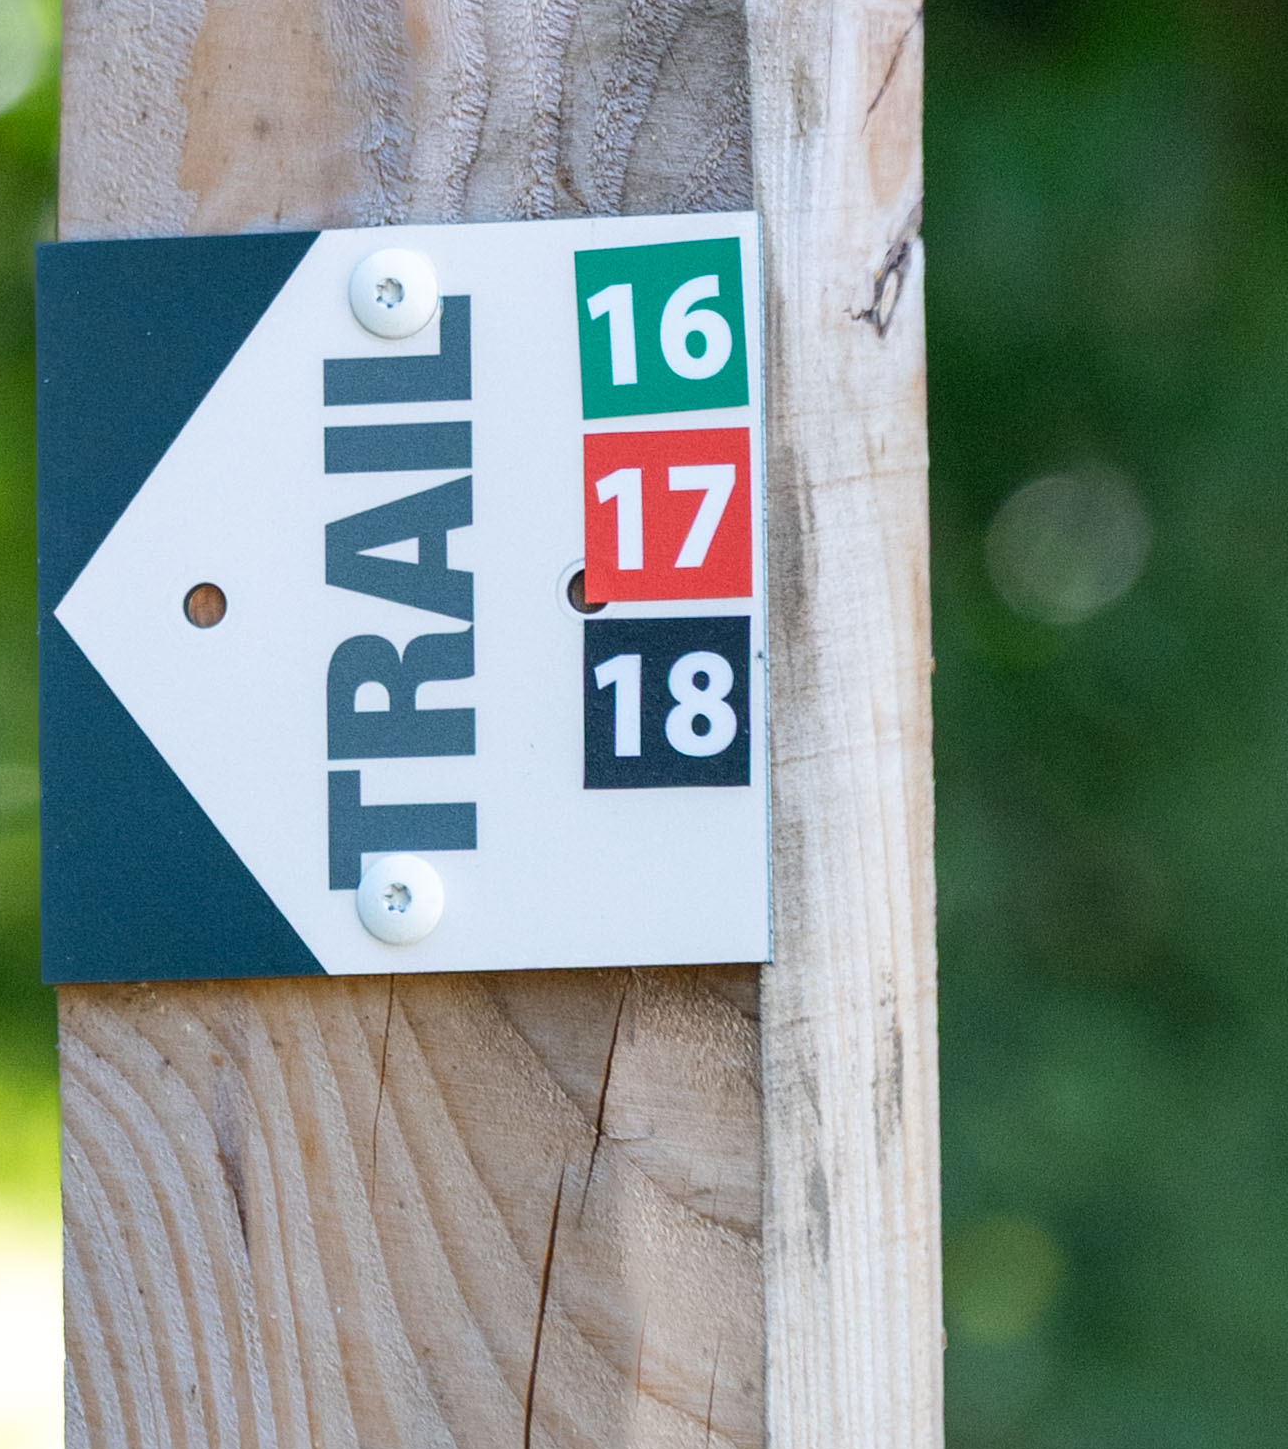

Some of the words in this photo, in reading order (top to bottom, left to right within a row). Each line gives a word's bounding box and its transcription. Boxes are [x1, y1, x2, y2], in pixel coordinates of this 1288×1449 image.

[586, 274, 734, 386] 16
[595, 463, 737, 571] 17
[323, 294, 478, 891] TRAIL
[593, 650, 738, 759] 18
